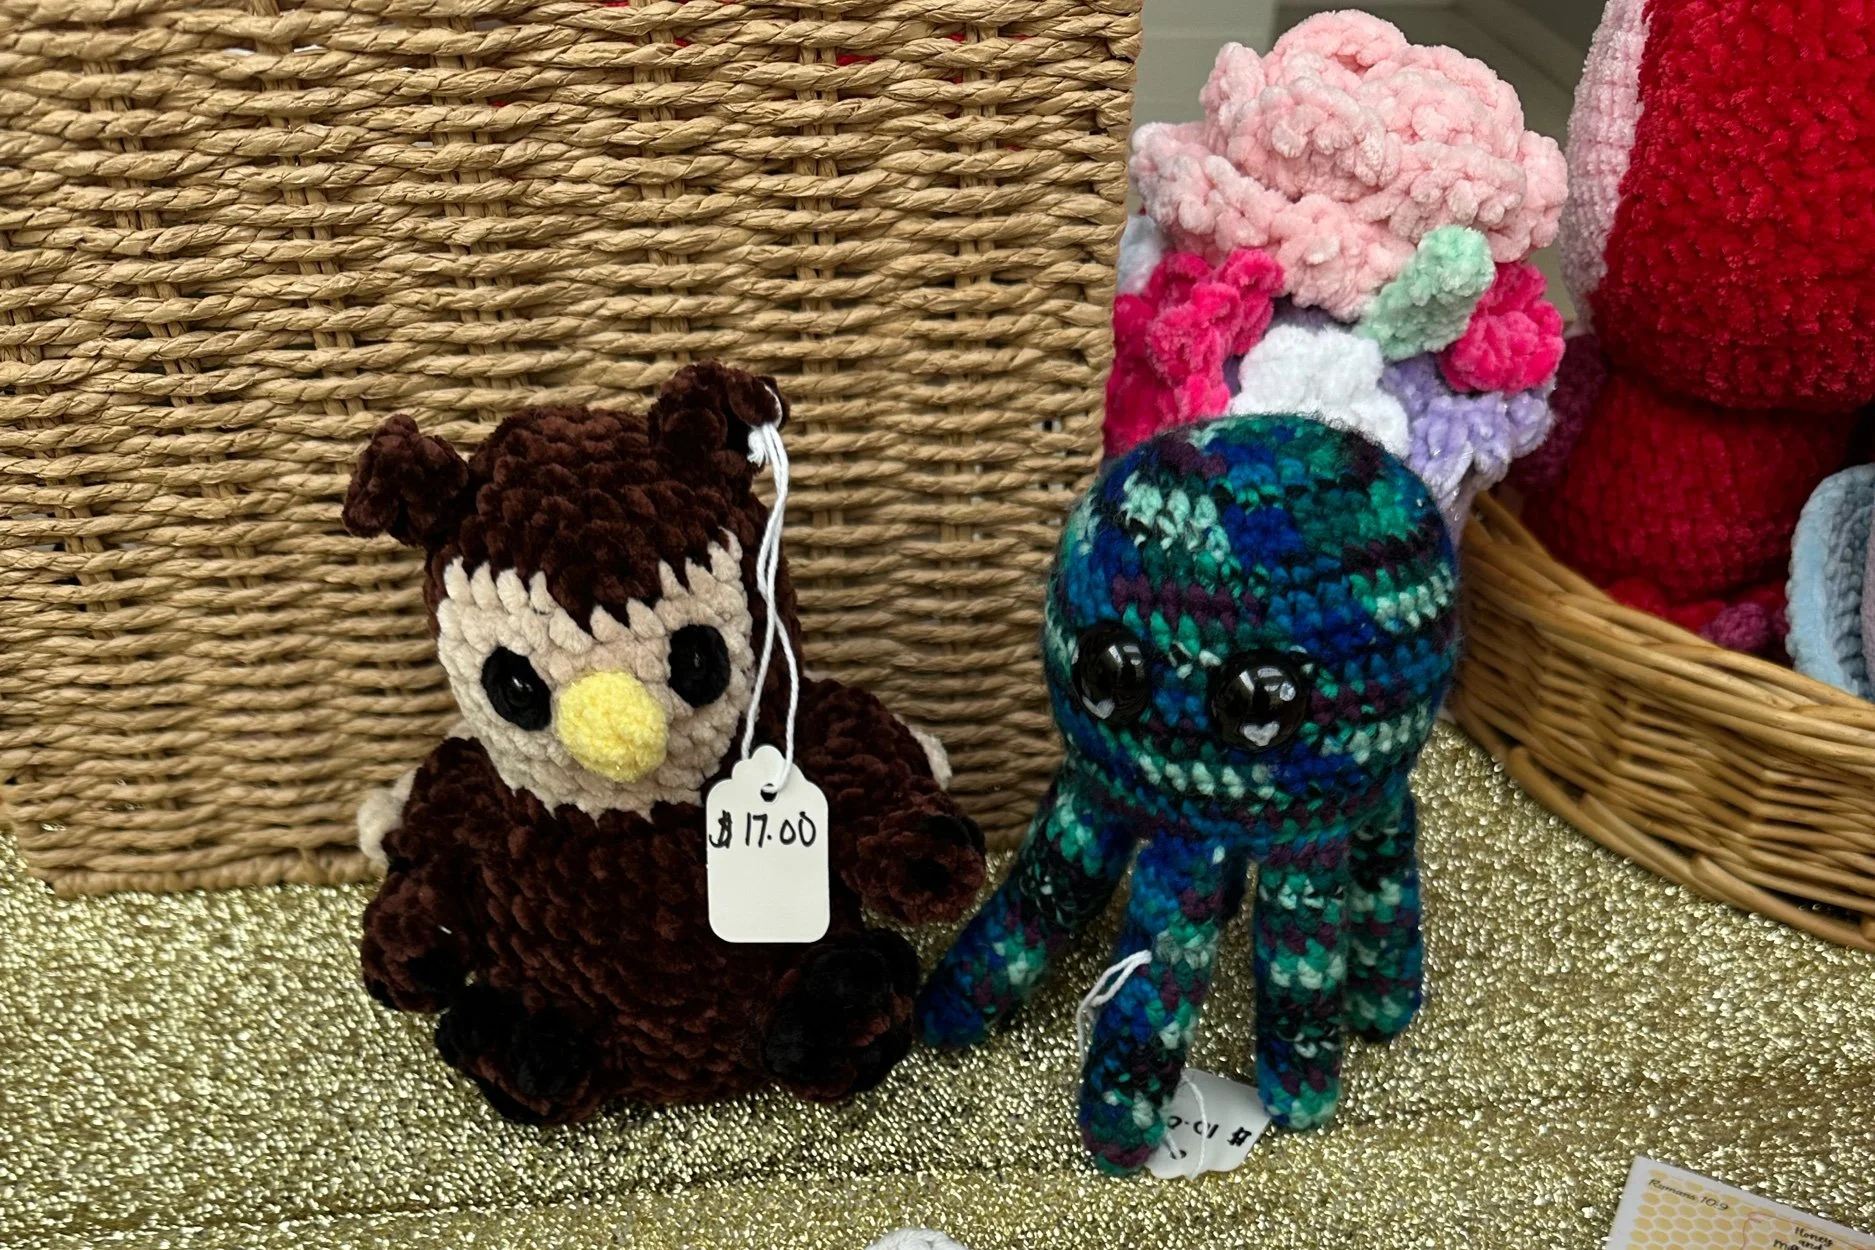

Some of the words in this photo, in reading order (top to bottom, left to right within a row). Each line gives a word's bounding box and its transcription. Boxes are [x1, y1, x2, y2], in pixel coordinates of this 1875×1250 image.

[1648, 1179, 1696, 1201] Romans
[1700, 1196, 1729, 1211] 10:9
[1794, 1226, 1833, 1247] Honey
